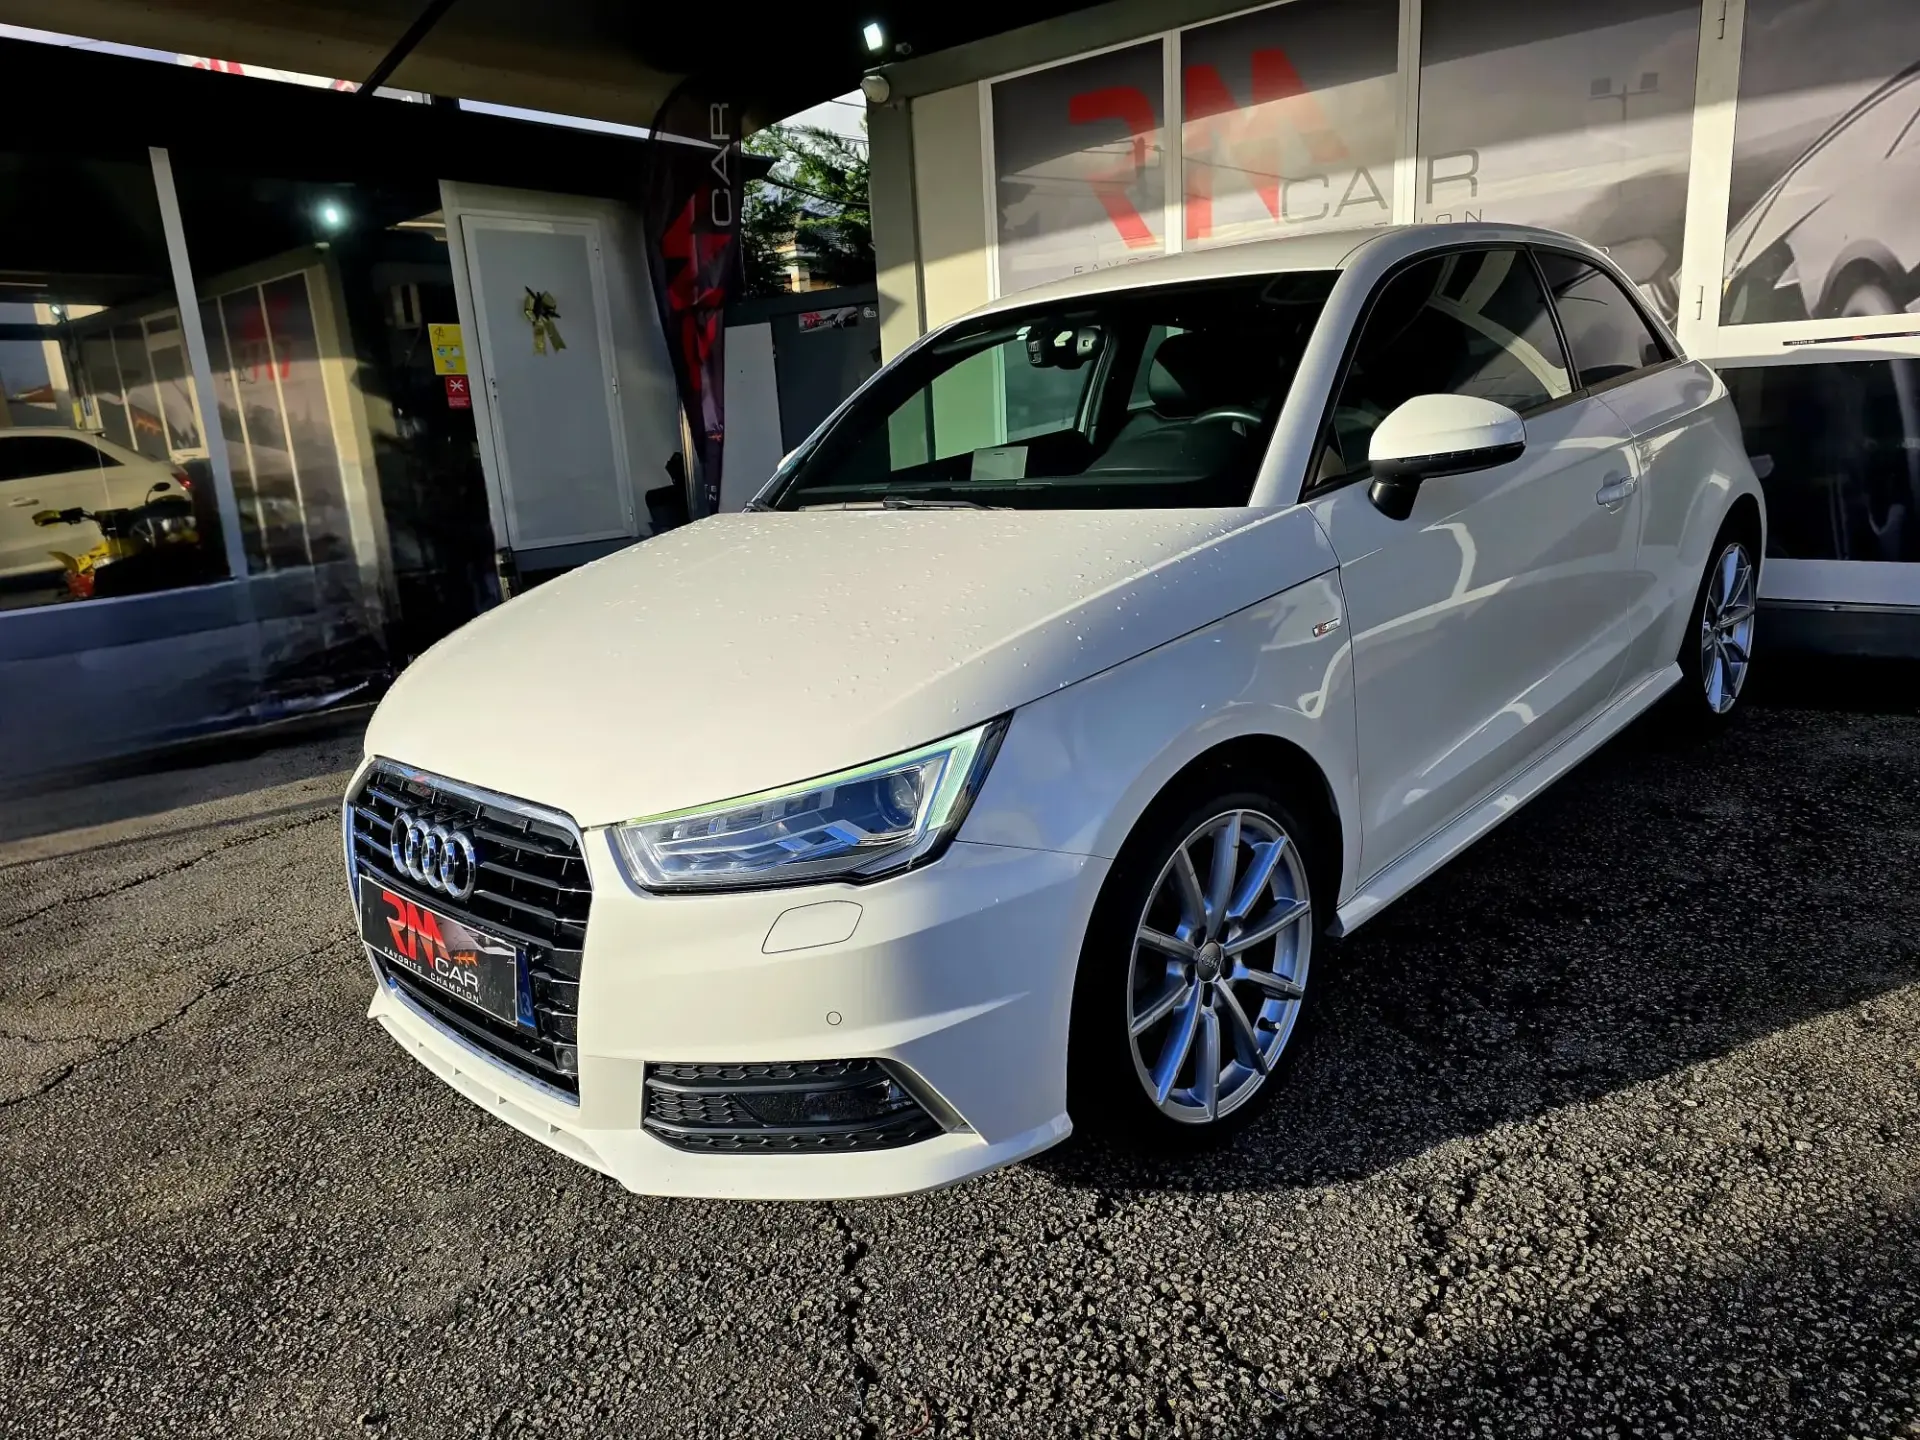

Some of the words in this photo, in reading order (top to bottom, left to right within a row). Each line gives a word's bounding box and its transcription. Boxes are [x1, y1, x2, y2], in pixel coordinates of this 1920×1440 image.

[709, 100, 733, 228] CAR
[1281, 148, 1481, 225] CAR
[382, 890, 451, 969] RM
[435, 956, 479, 994] CAR
[384, 946, 422, 974] FAVORITE
[430, 972, 480, 1005] CHAMPION
